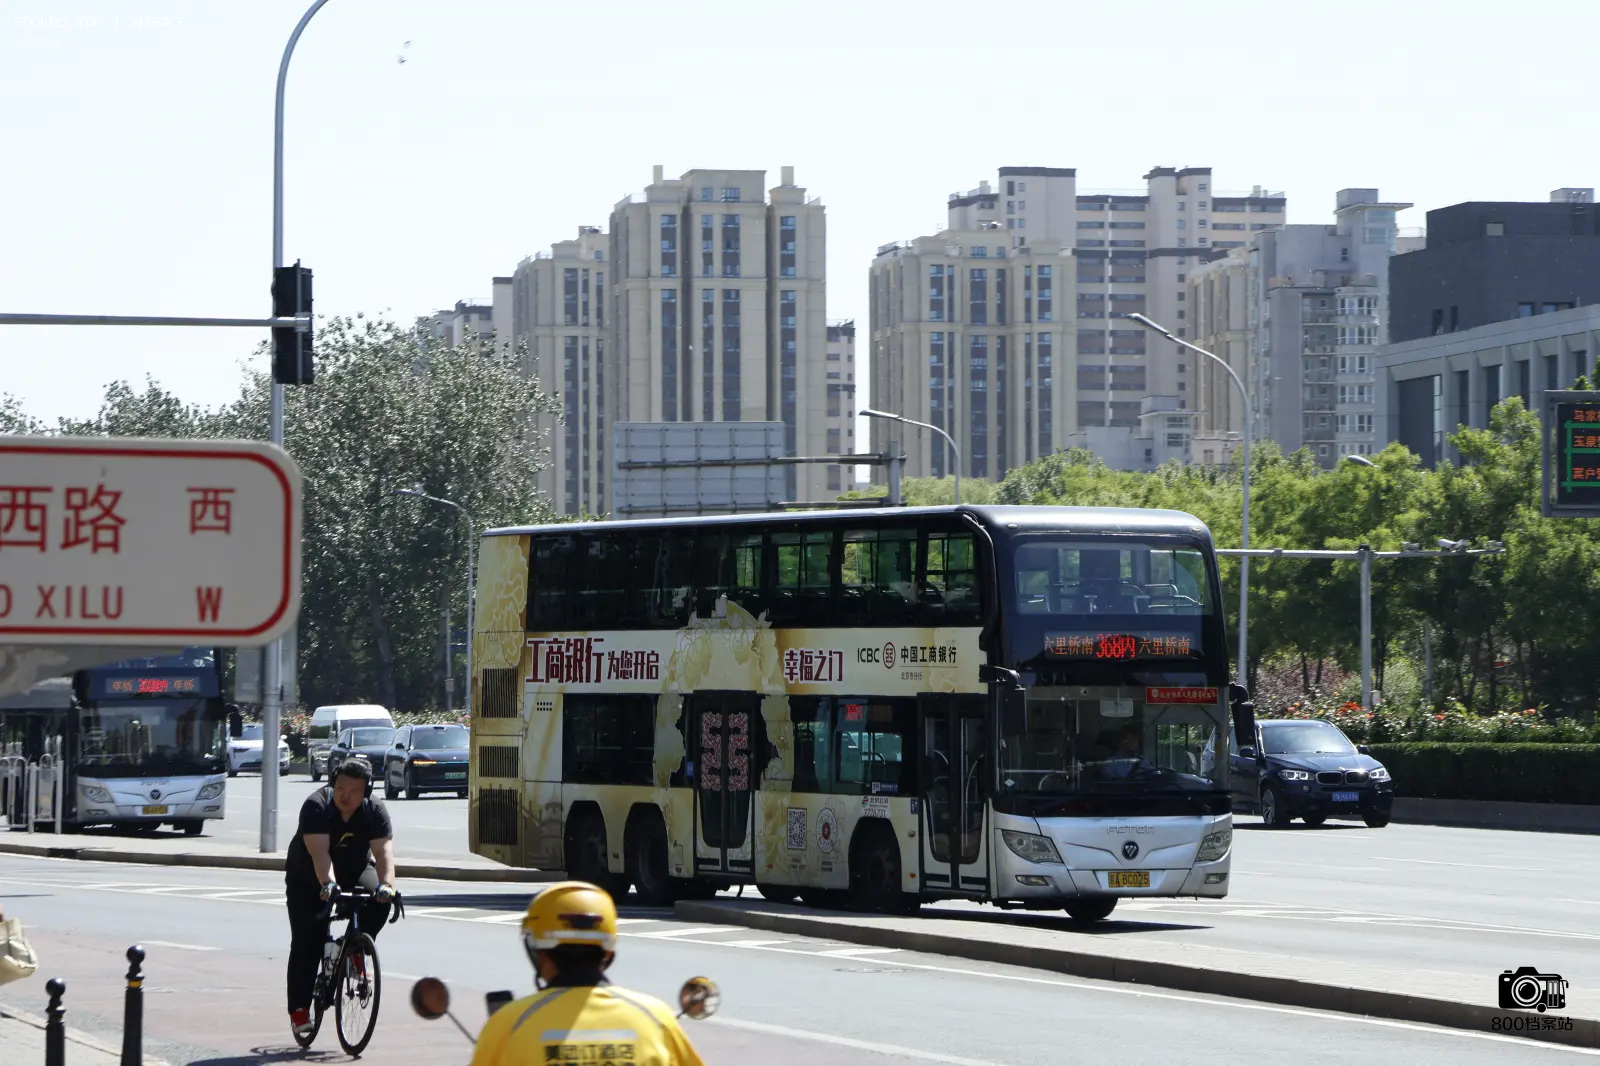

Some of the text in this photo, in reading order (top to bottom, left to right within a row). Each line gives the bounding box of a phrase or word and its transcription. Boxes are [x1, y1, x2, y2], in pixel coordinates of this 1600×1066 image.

[0, 484, 127, 555] 西路
[186, 486, 237, 535] 西
[196, 586, 223, 623] W
[526, 637, 843, 683] 工商银行 为您开启 幸福之门
[857, 646, 957, 663] ICBC 中国工商银行
[1044, 636, 1093, 655] 六里桥南
[1138, 636, 1190, 656] 六里桥南
